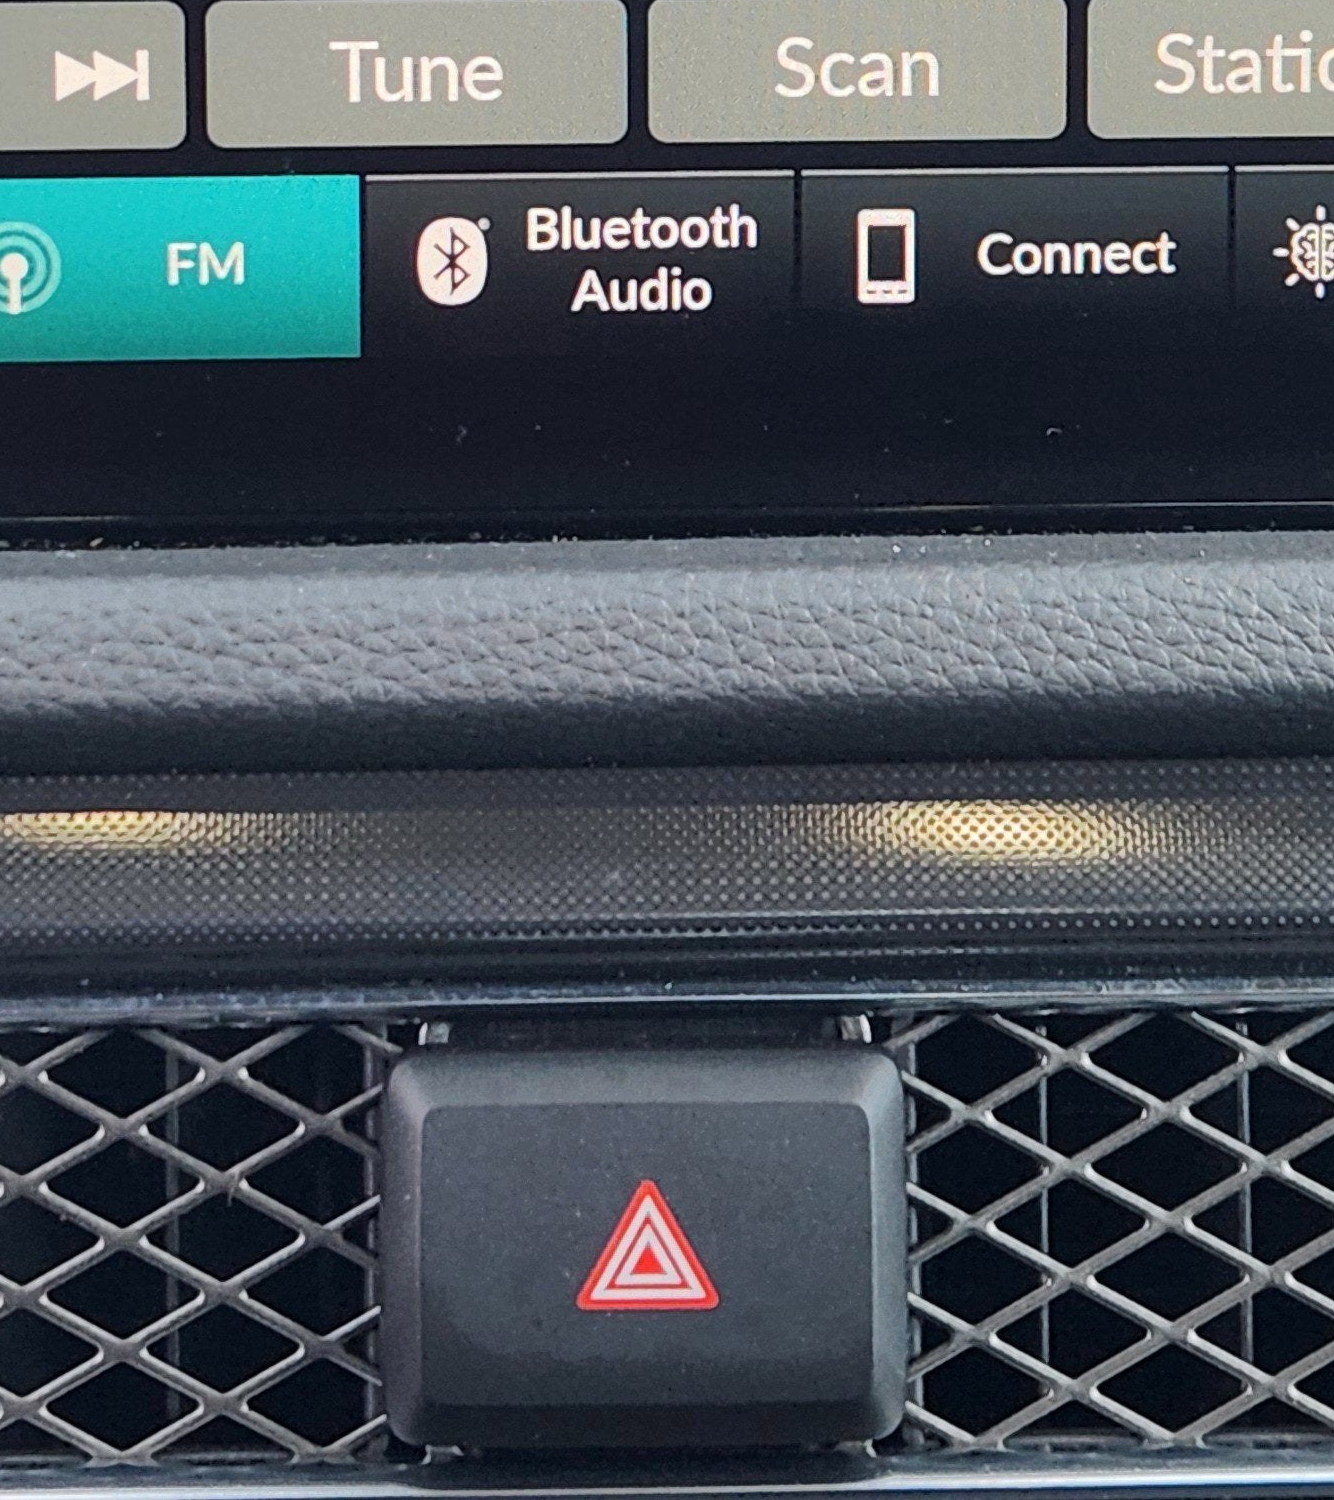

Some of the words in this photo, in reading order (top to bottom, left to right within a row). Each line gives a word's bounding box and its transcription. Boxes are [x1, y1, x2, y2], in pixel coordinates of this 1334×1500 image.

[328, 39, 505, 105] Tune
[774, 36, 941, 99] Scan
[525, 204, 761, 252] Bluetooth
[167, 241, 247, 287] FM
[976, 232, 1179, 277] Connect
[571, 266, 714, 314] Audio
